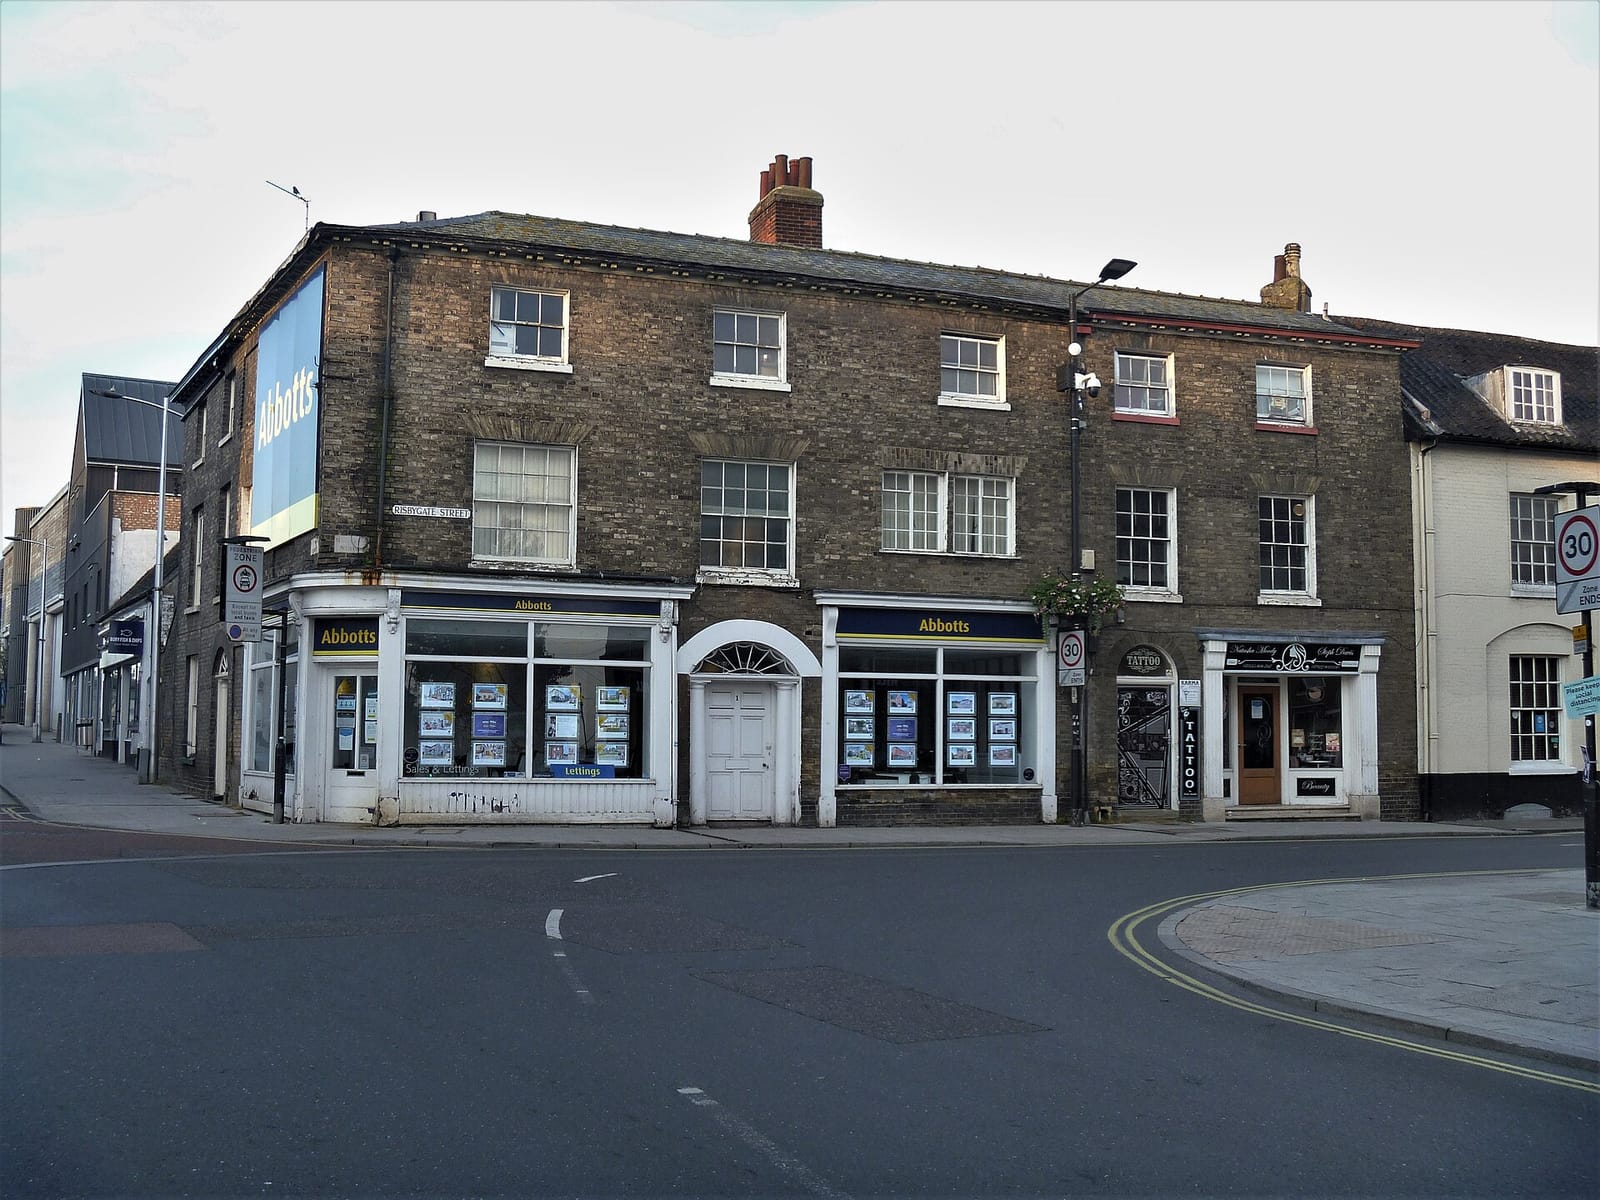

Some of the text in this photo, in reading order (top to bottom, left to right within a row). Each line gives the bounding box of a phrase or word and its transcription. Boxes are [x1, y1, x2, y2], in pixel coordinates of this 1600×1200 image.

[258, 366, 314, 451] Abbotts
[394, 506, 469, 518] RISBYGATE STREET
[1564, 531, 1592, 559] 30
[234, 553, 257, 562] ZONE
[1582, 585, 1599, 594] Zone
[515, 599, 552, 611] Abbotts
[1579, 594, 1600, 606] ENDS
[919, 617, 970, 633] Abbotts
[321, 627, 376, 644] Abbotts
[1064, 643, 1080, 657] 30
[1127, 655, 1161, 666] TATTOO
[1566, 686, 1584, 695] Please
[1575, 690, 1592, 699] social
[1185, 721, 1195, 789] TATTOO
[405, 763, 480, 776] Sales & Lettings
[565, 766, 600, 778] Lettings
